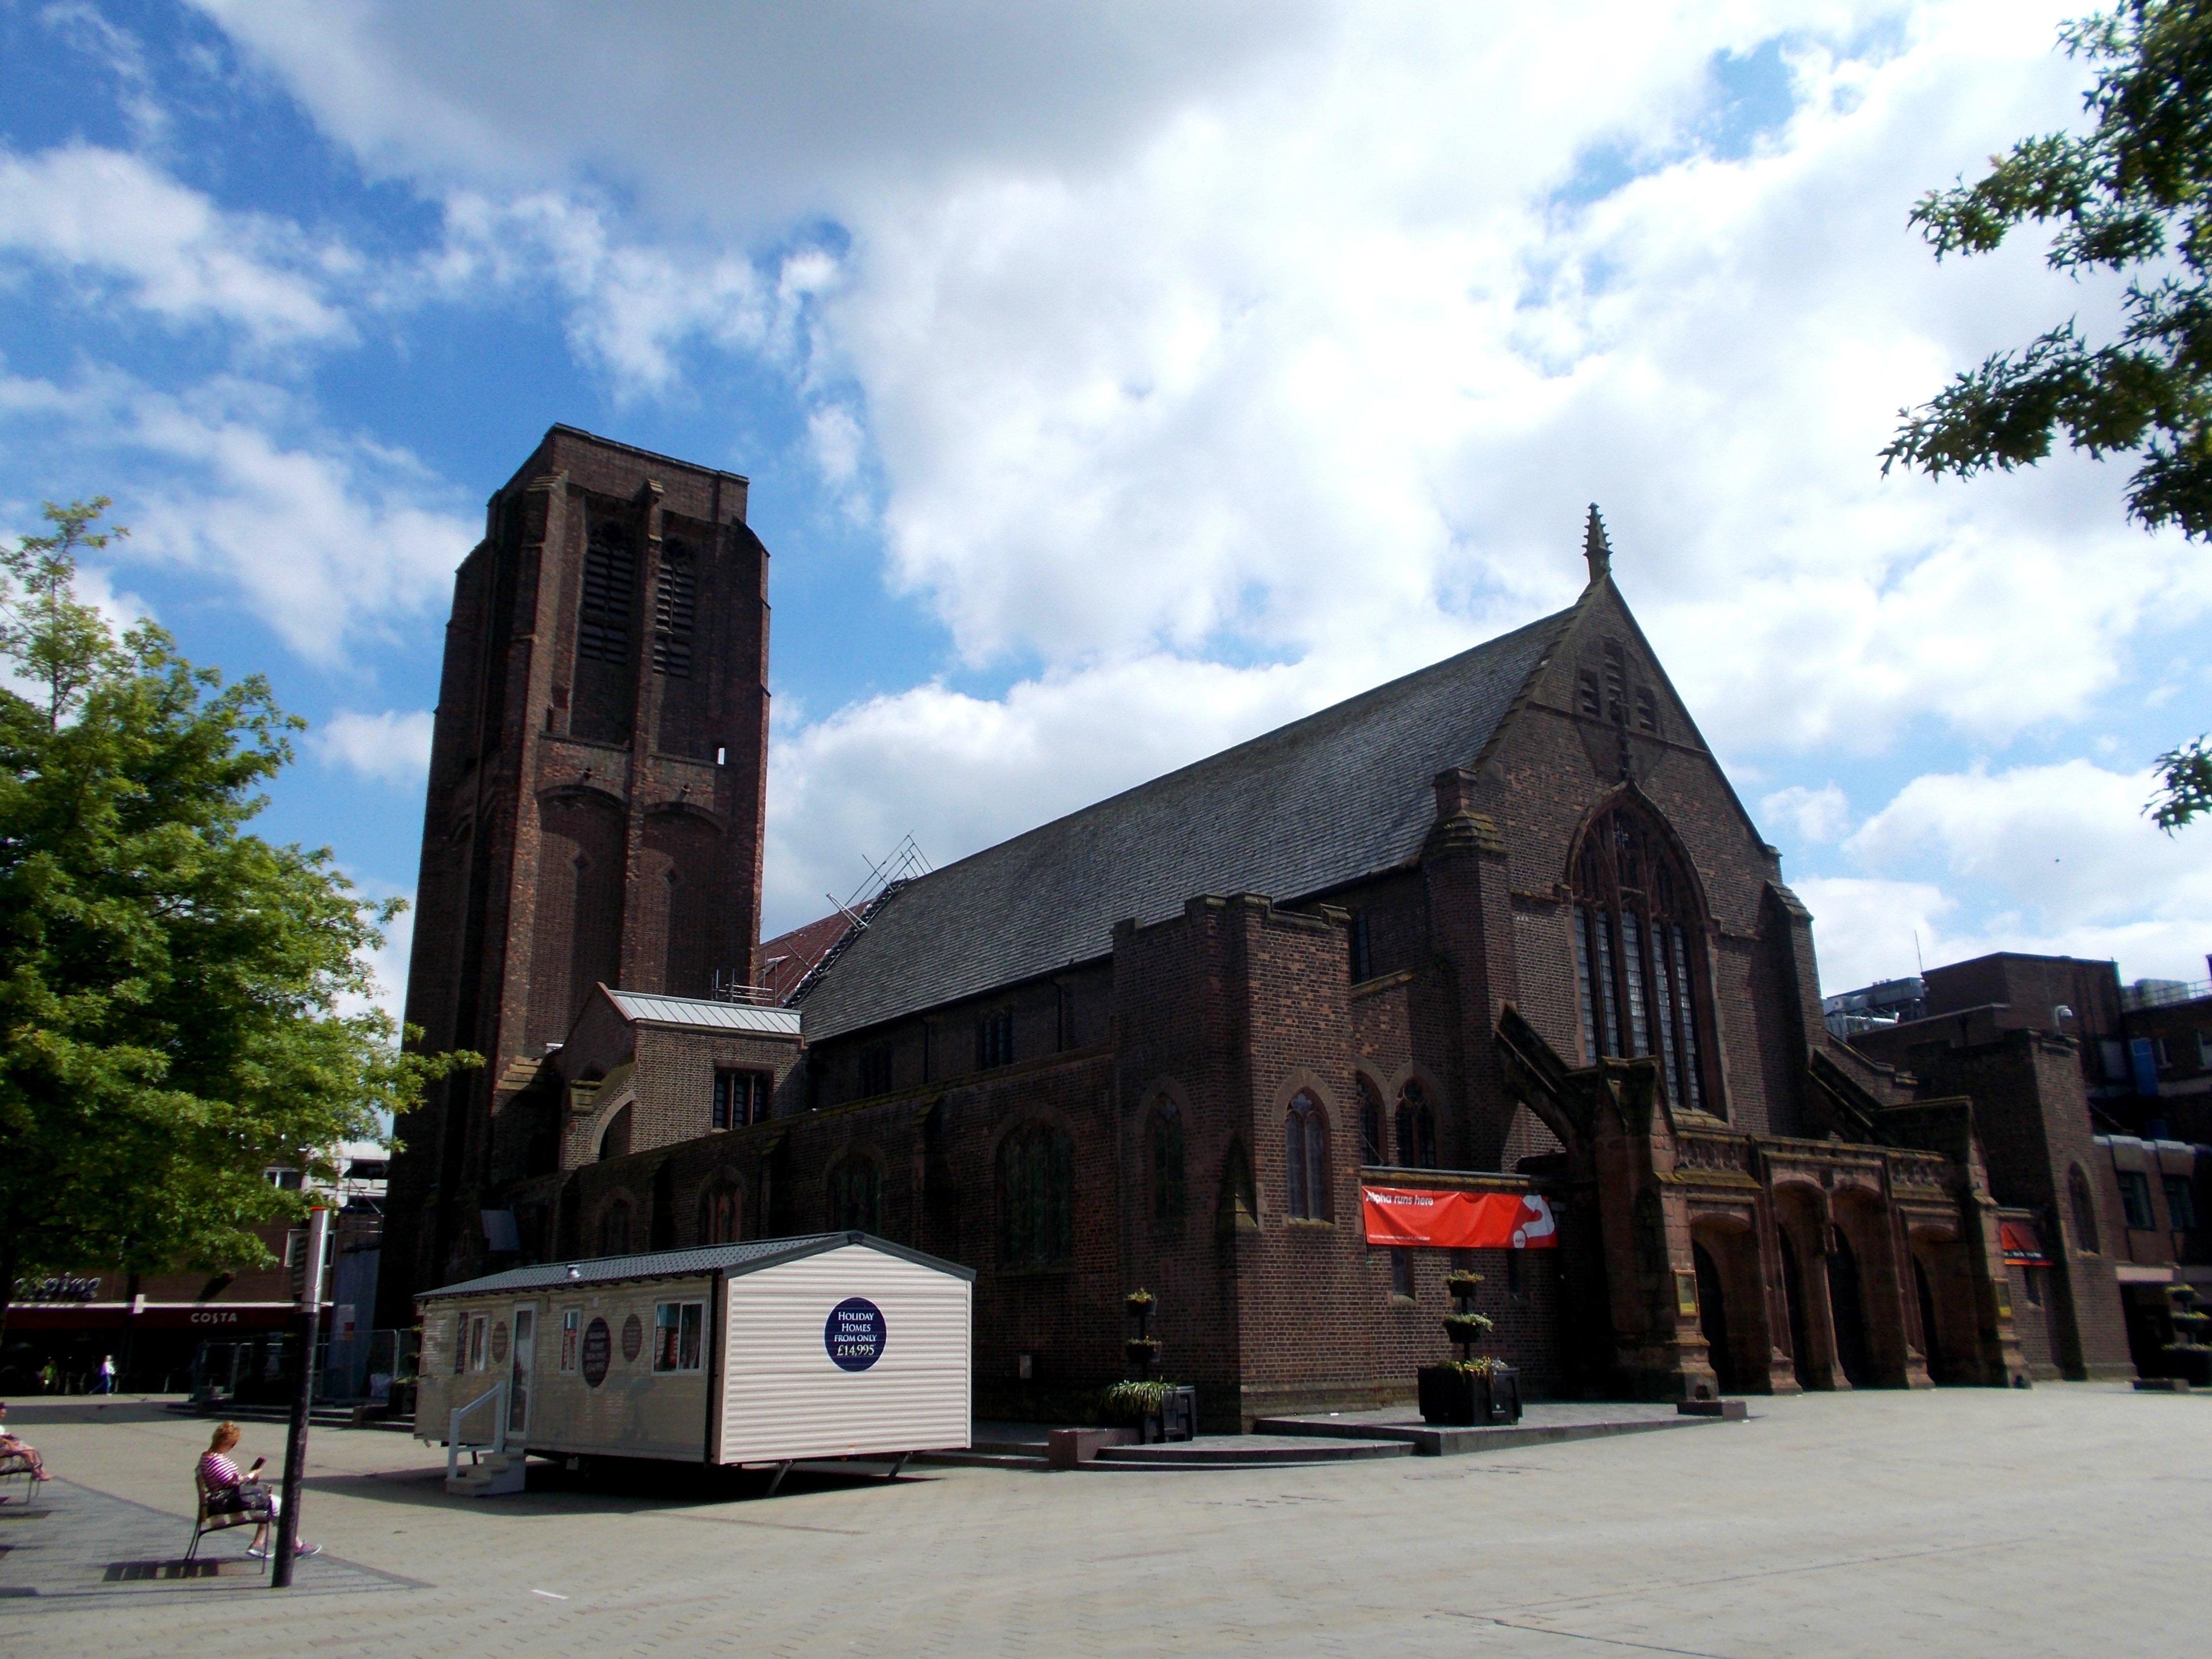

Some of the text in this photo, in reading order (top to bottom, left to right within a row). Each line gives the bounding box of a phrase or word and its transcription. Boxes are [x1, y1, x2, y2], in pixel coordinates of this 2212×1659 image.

[1366, 1191, 1434, 1206] Alpha runs here
[190, 1312, 237, 1323] COSTA
[838, 1311, 874, 1320] HOLIDAY
[841, 1323, 871, 1332] HOMES
